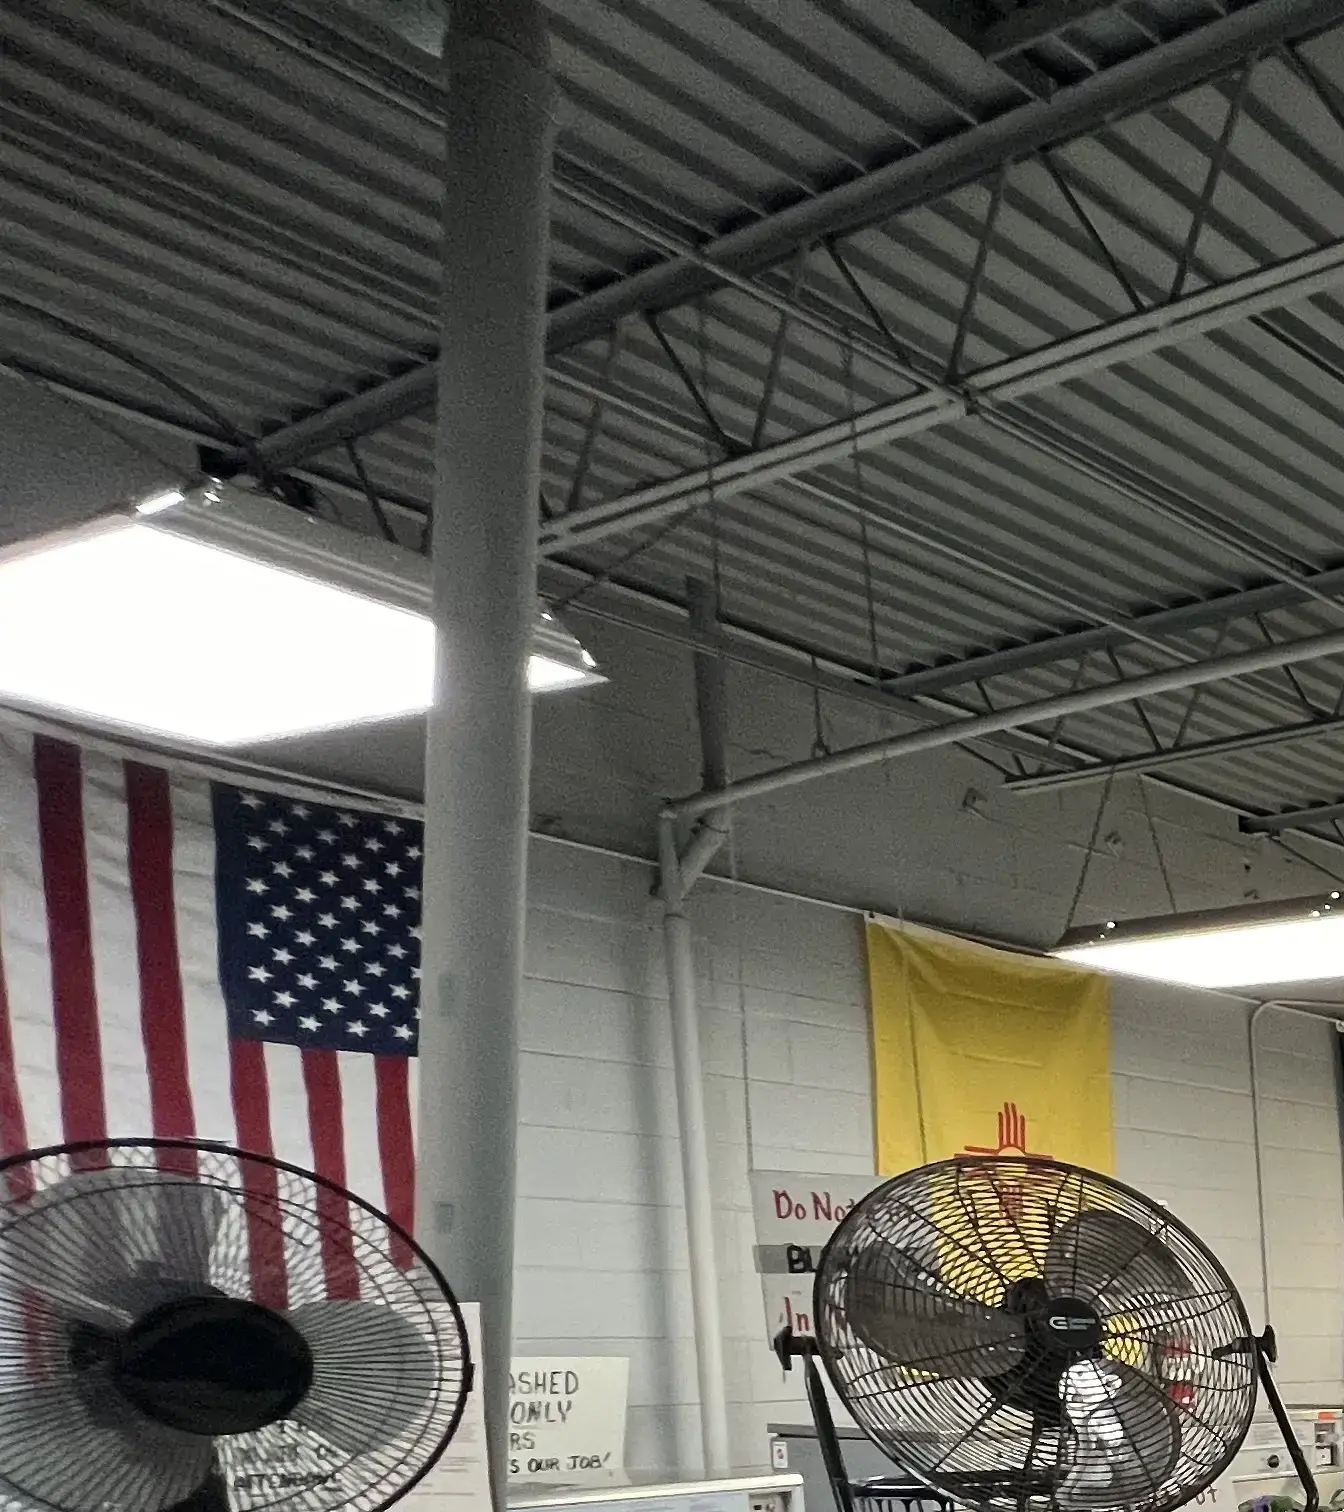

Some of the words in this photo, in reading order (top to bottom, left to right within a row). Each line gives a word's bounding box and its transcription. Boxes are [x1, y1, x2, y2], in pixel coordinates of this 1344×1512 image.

[773, 1189, 806, 1220] Do
[510, 1399, 573, 1424] ONLY
[527, 1458, 560, 1473] OUR
